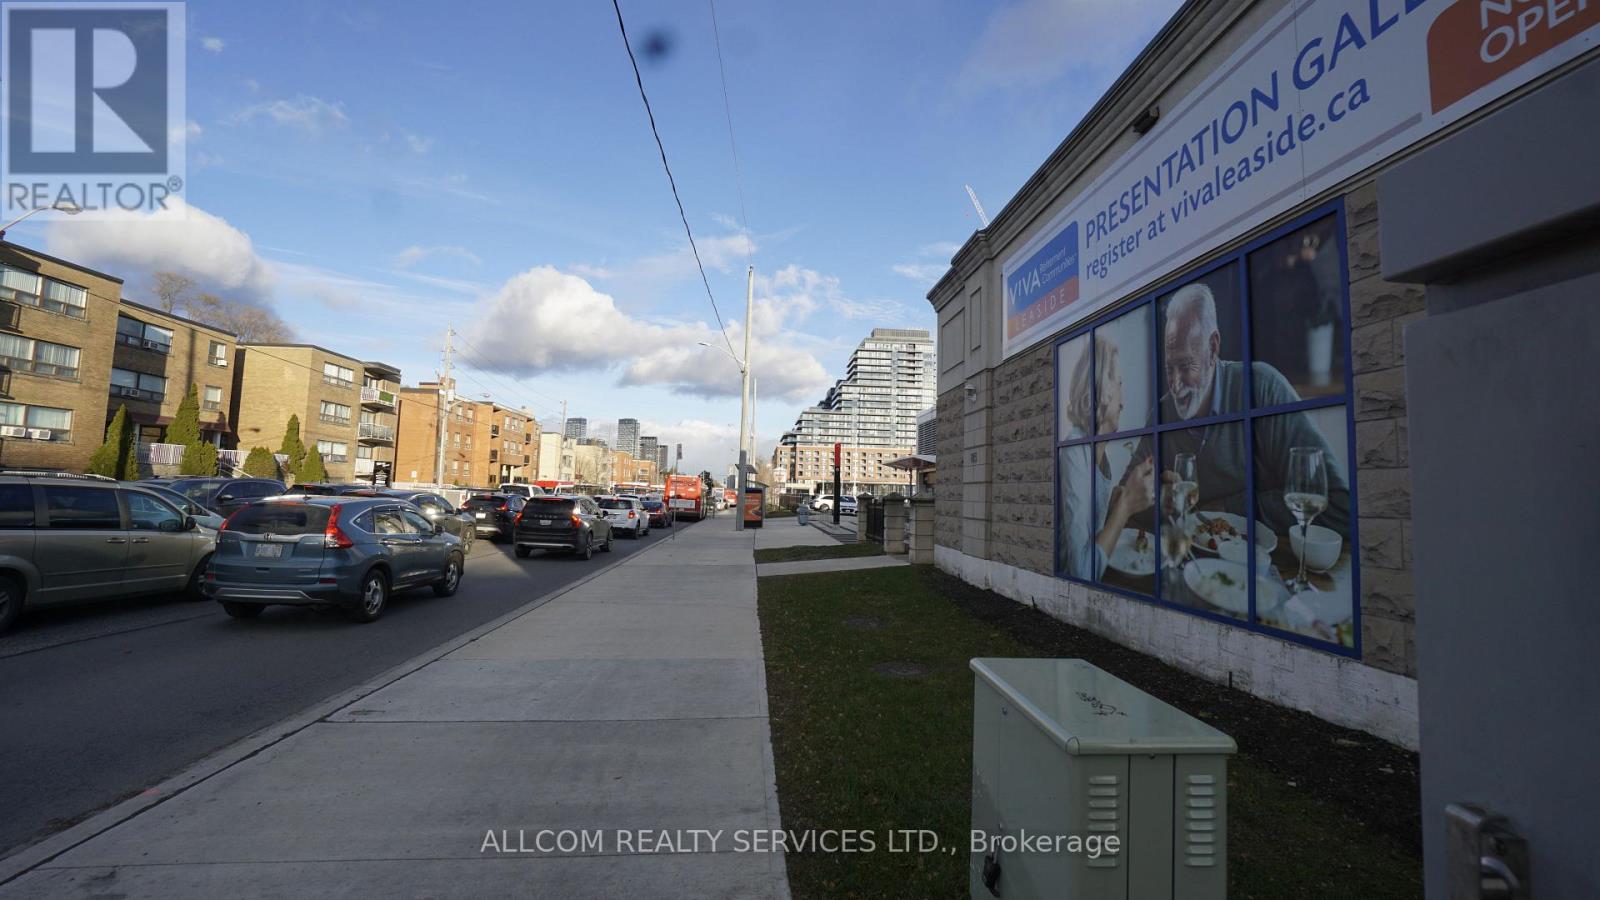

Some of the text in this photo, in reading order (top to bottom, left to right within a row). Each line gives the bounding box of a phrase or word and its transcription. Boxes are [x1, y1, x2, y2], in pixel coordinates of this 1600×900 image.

[1480, 0, 1587, 63] OPE
[1086, 0, 1427, 249] PRESENTATION GAL
[1086, 78, 1371, 280] register at vivaleaside.ca
[1009, 268, 1041, 305] VIVA
[1015, 288, 1066, 332] LEASIDE
